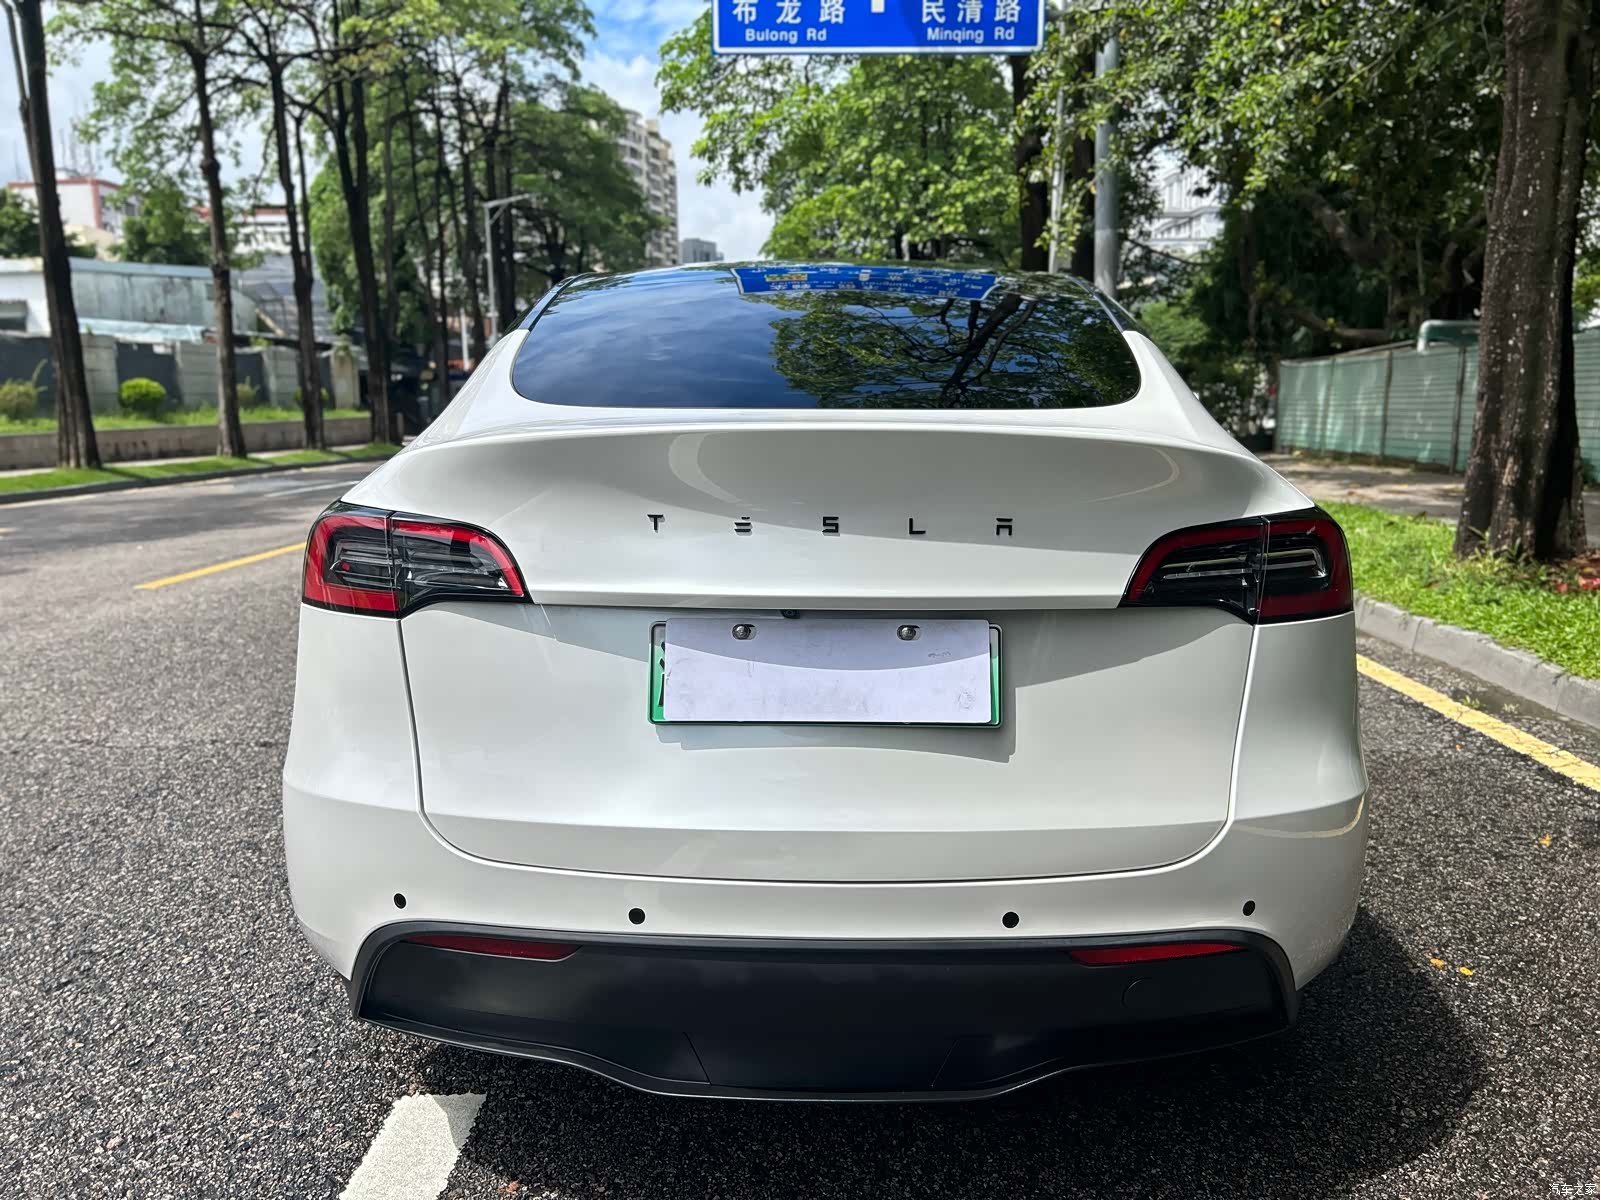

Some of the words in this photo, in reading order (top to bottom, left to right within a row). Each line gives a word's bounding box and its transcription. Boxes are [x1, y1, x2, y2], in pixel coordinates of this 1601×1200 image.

[732, 0, 846, 24] 布龙路
[921, 0, 1022, 23] 民清路
[745, 27, 798, 44] Bulong
[806, 27, 827, 41] Rd
[927, 27, 984, 43] Minqing
[994, 26, 1015, 40] Rd
[647, 513, 1014, 537] TESLA
